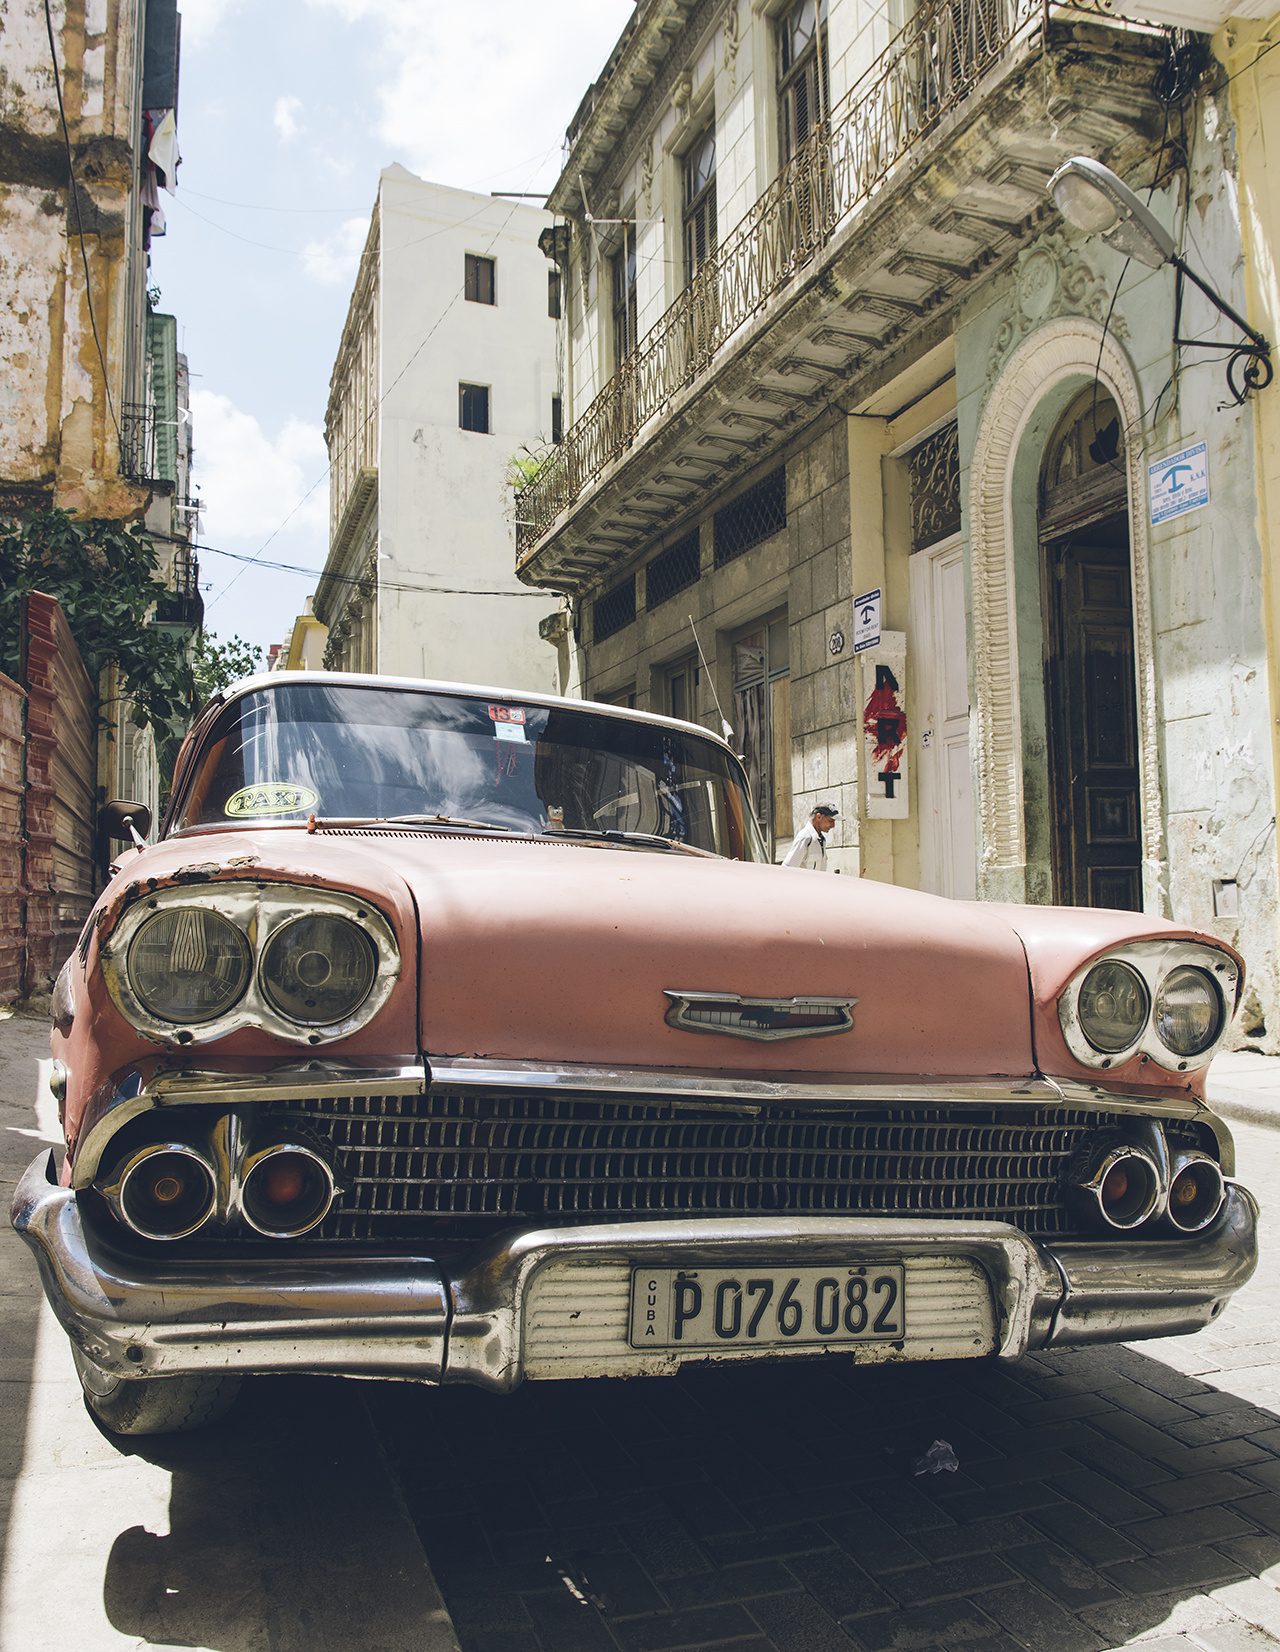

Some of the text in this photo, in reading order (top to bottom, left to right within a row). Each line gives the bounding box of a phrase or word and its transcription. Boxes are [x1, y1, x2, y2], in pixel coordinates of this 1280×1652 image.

[1150, 444, 1205, 474] ARRENDADOR DIVISA
[490, 706, 510, 720] 13
[875, 664, 901, 798] ART
[235, 790, 305, 812] TAXI
[645, 1280, 657, 1336] CUBA
[673, 1276, 898, 1340] P 076 082
